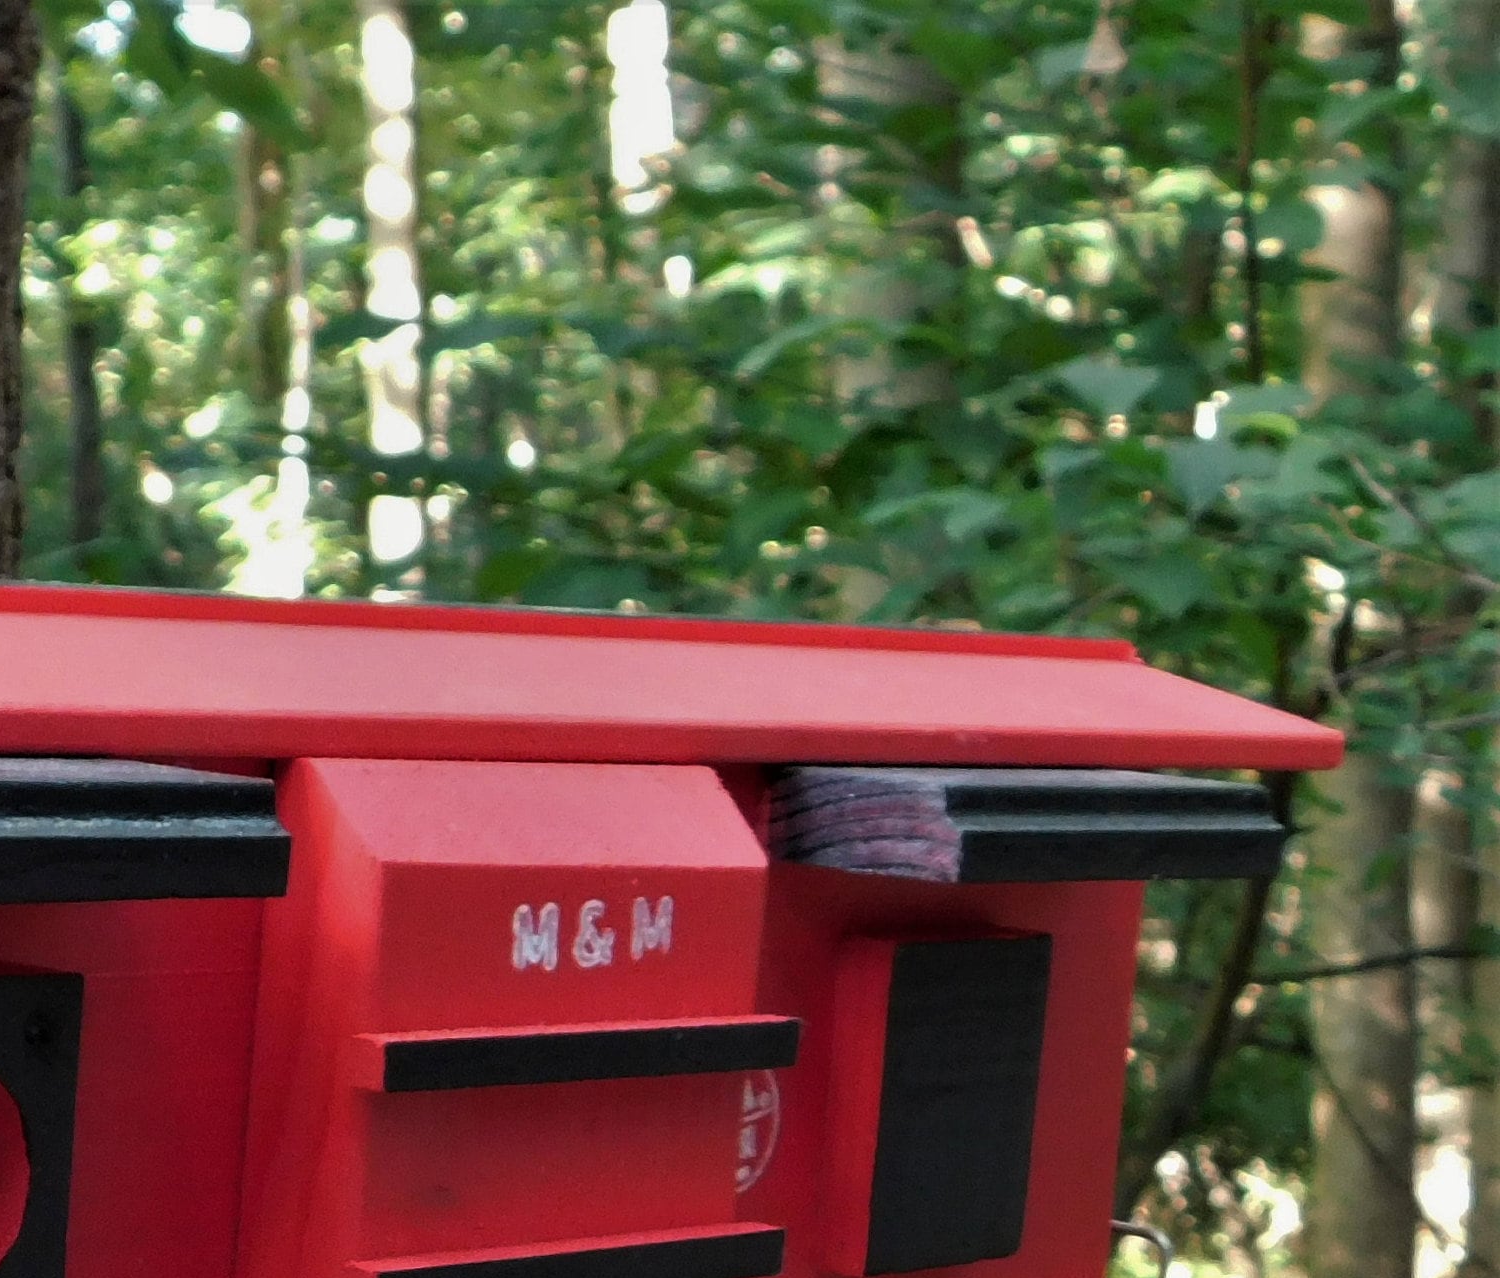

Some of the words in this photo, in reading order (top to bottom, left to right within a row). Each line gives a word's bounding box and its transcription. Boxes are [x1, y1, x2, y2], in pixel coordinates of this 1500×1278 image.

[512, 901, 559, 971] M
[573, 899, 615, 968] &
[631, 895, 674, 960] M
